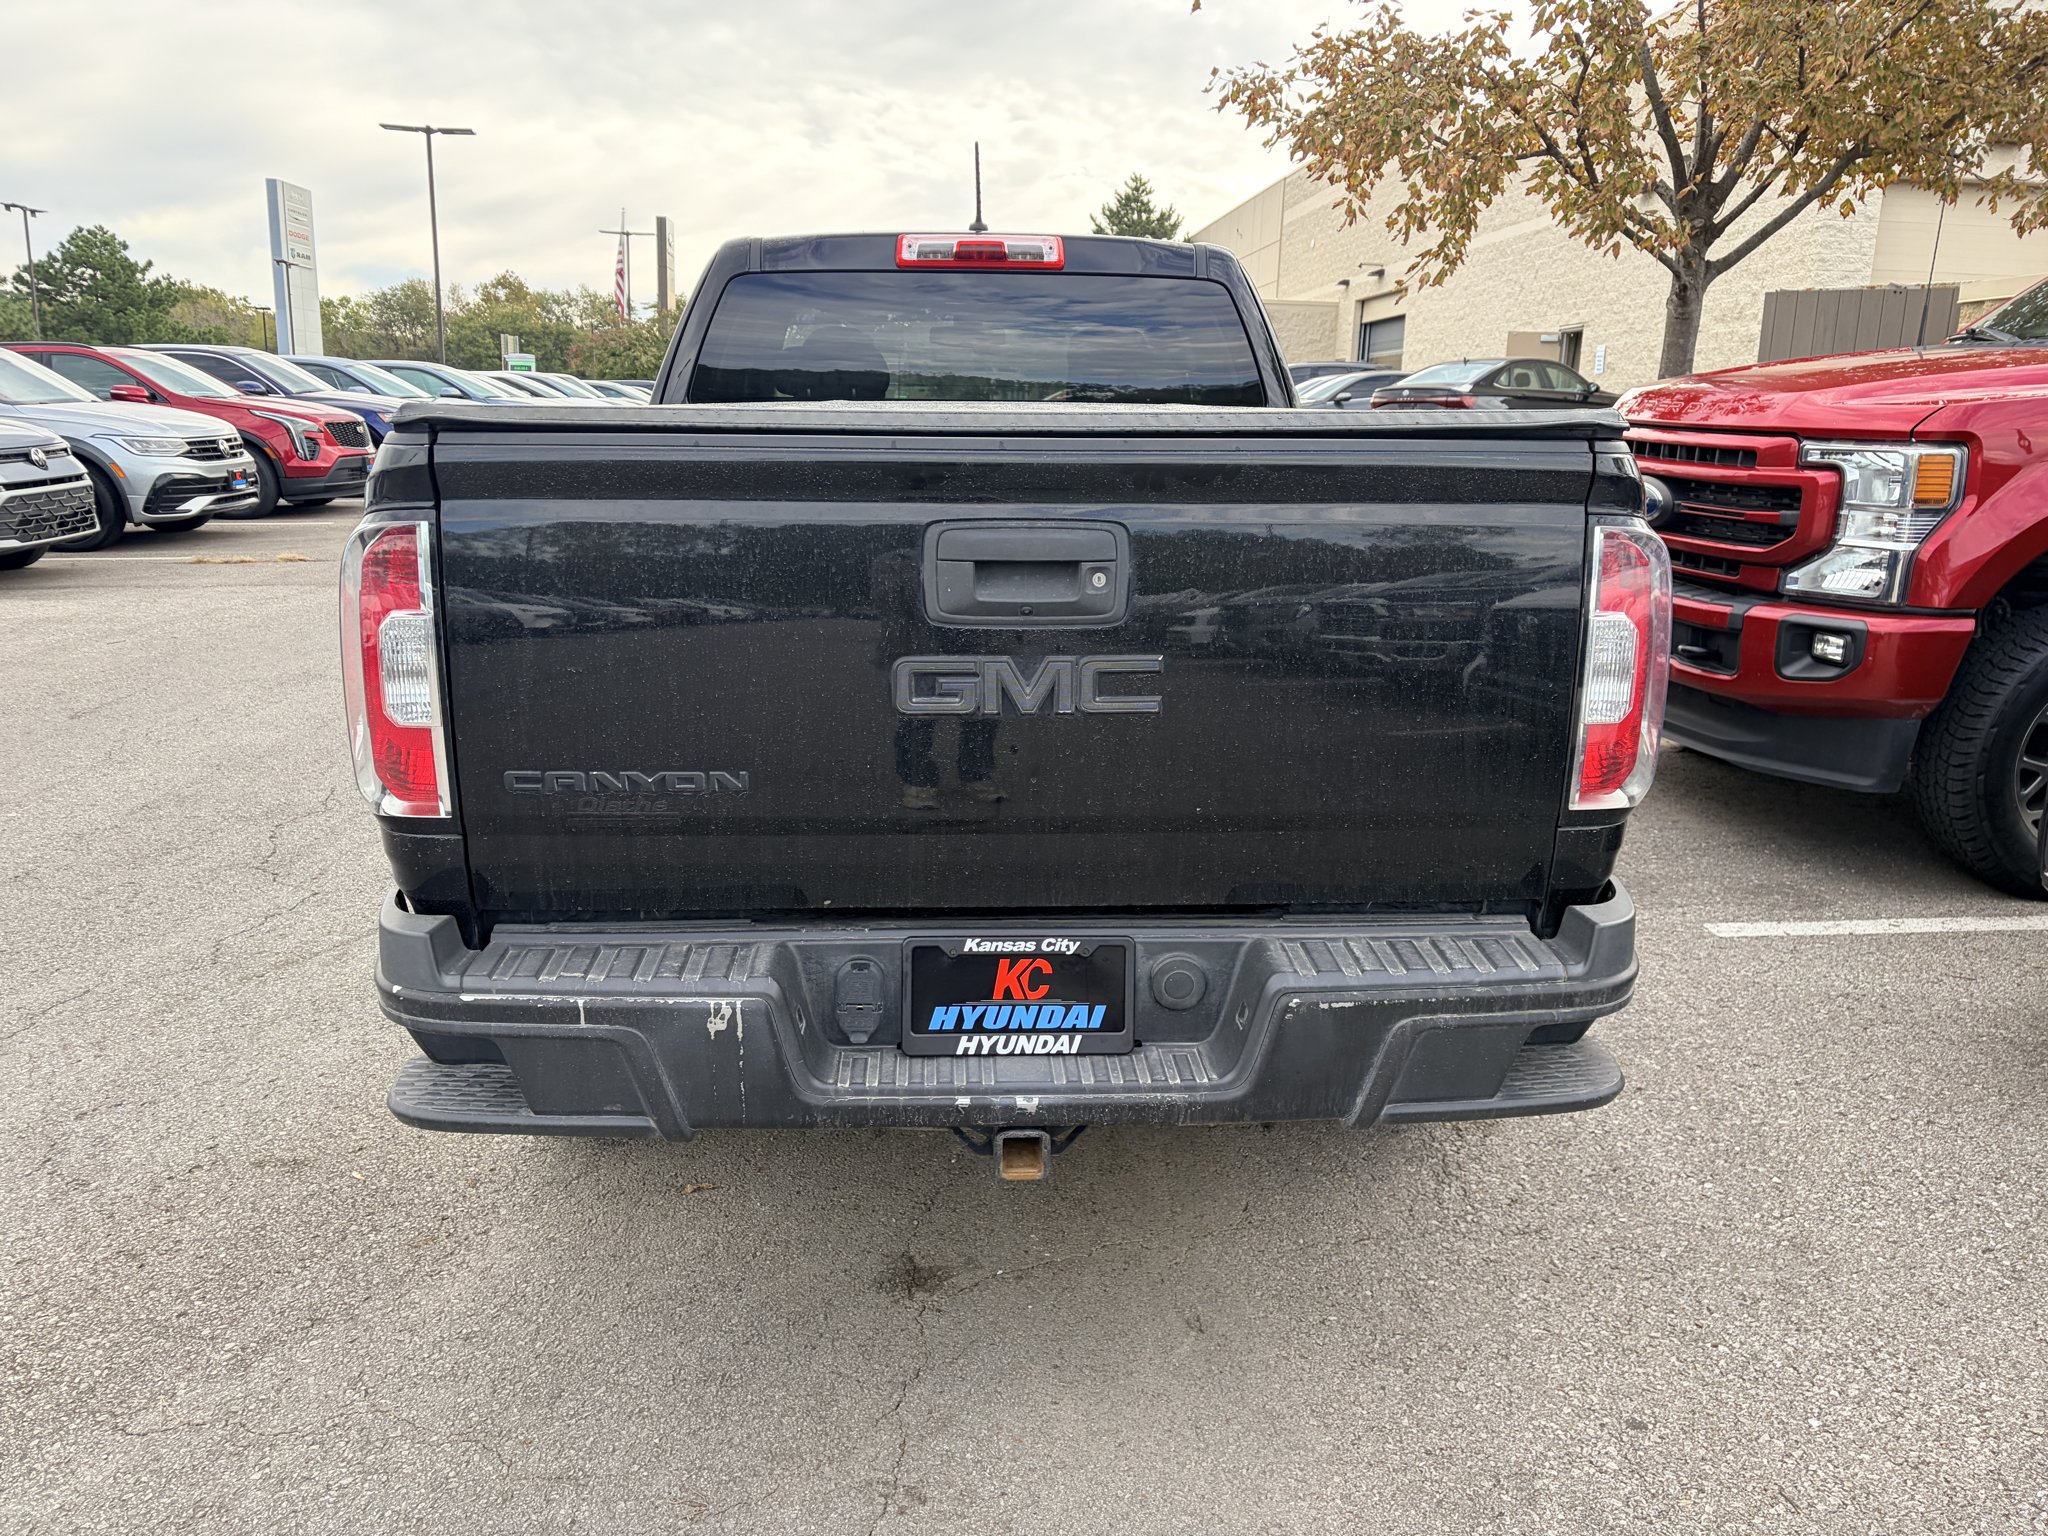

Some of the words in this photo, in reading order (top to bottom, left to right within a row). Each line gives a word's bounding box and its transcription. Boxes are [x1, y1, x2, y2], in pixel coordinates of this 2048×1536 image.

[288, 230, 310, 241] DODGE
[296, 252, 311, 261] RAM
[892, 655, 1164, 716] GMC
[503, 770, 750, 793] CANYON
[963, 937, 1037, 953] Kansas
[1040, 937, 1081, 955] City
[993, 958, 1053, 1000] KC
[928, 1004, 1107, 1031] HYUNDAI
[955, 1034, 1083, 1055] HYUNDAI
